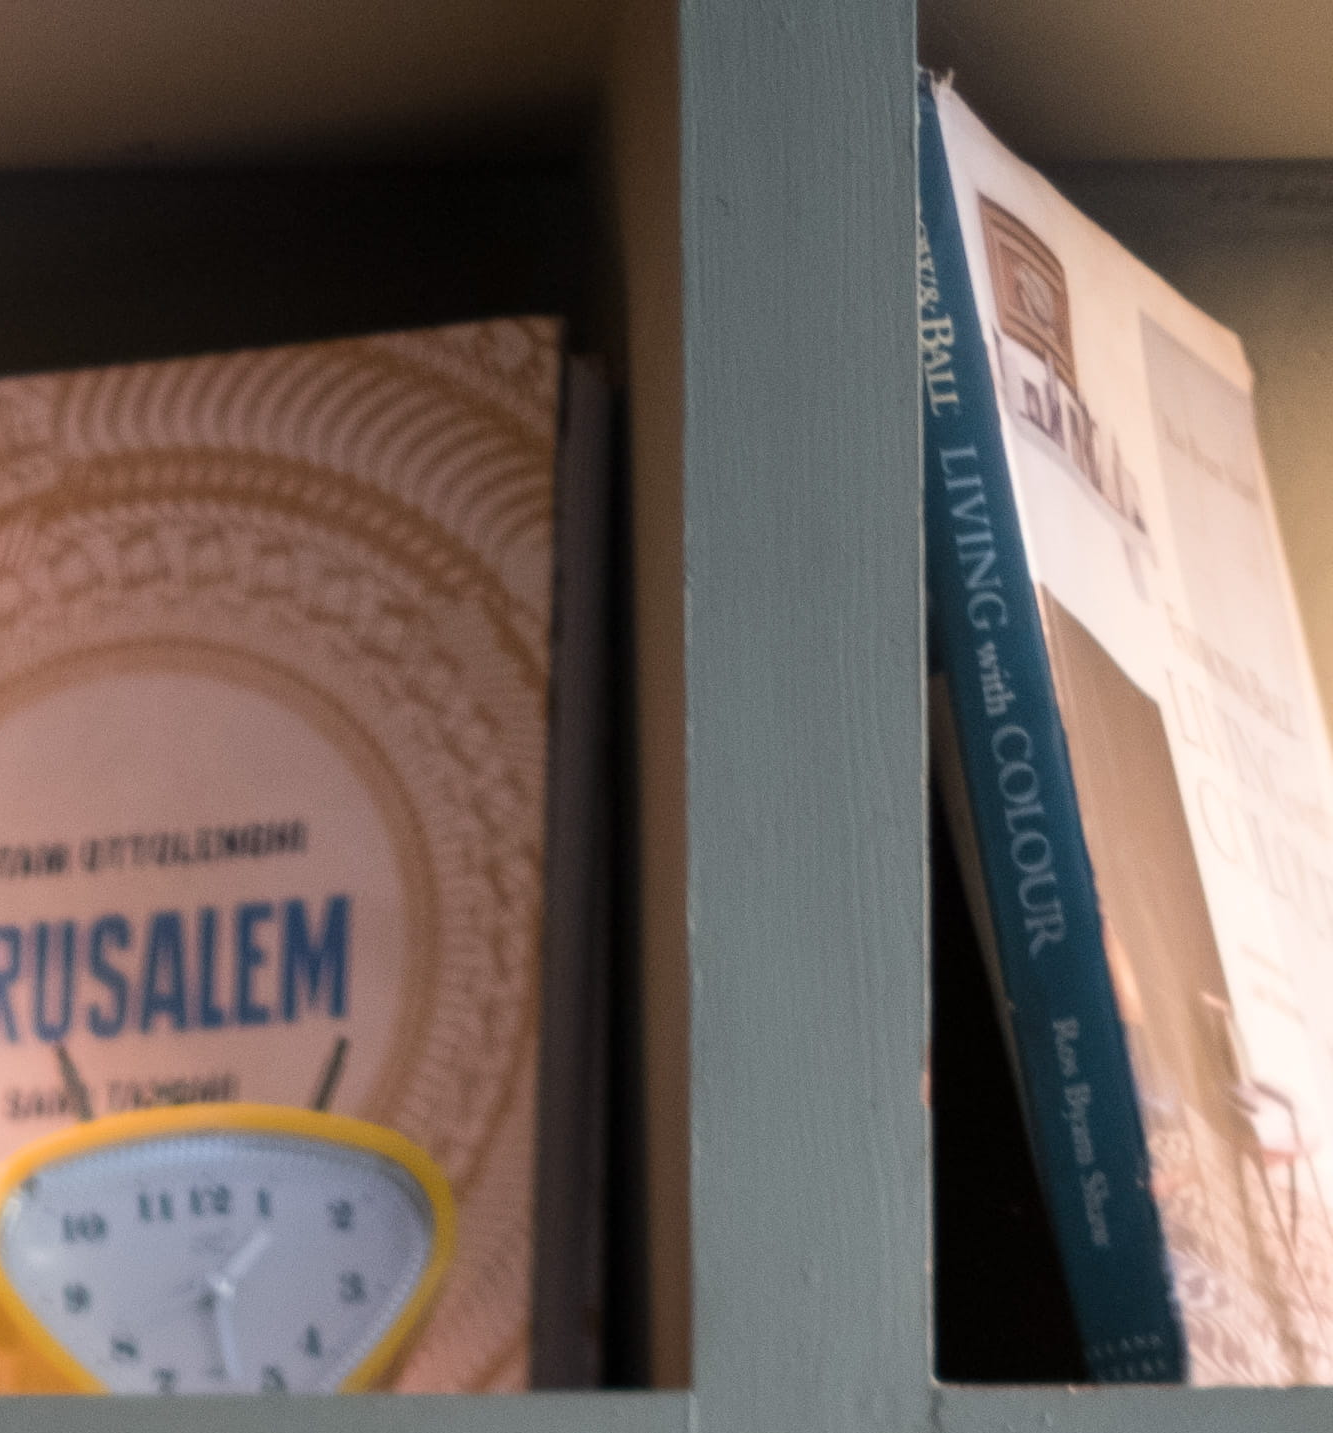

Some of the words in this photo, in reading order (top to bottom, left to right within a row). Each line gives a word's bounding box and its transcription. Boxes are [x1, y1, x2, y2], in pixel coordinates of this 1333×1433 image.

[939, 444, 1010, 632] LIVING
[975, 639, 1018, 718] with
[990, 724, 1068, 960] COLOUR
[5, 1083, 95, 1122] SAM
[137, 1190, 175, 1223] 11
[255, 1188, 272, 1220] 1
